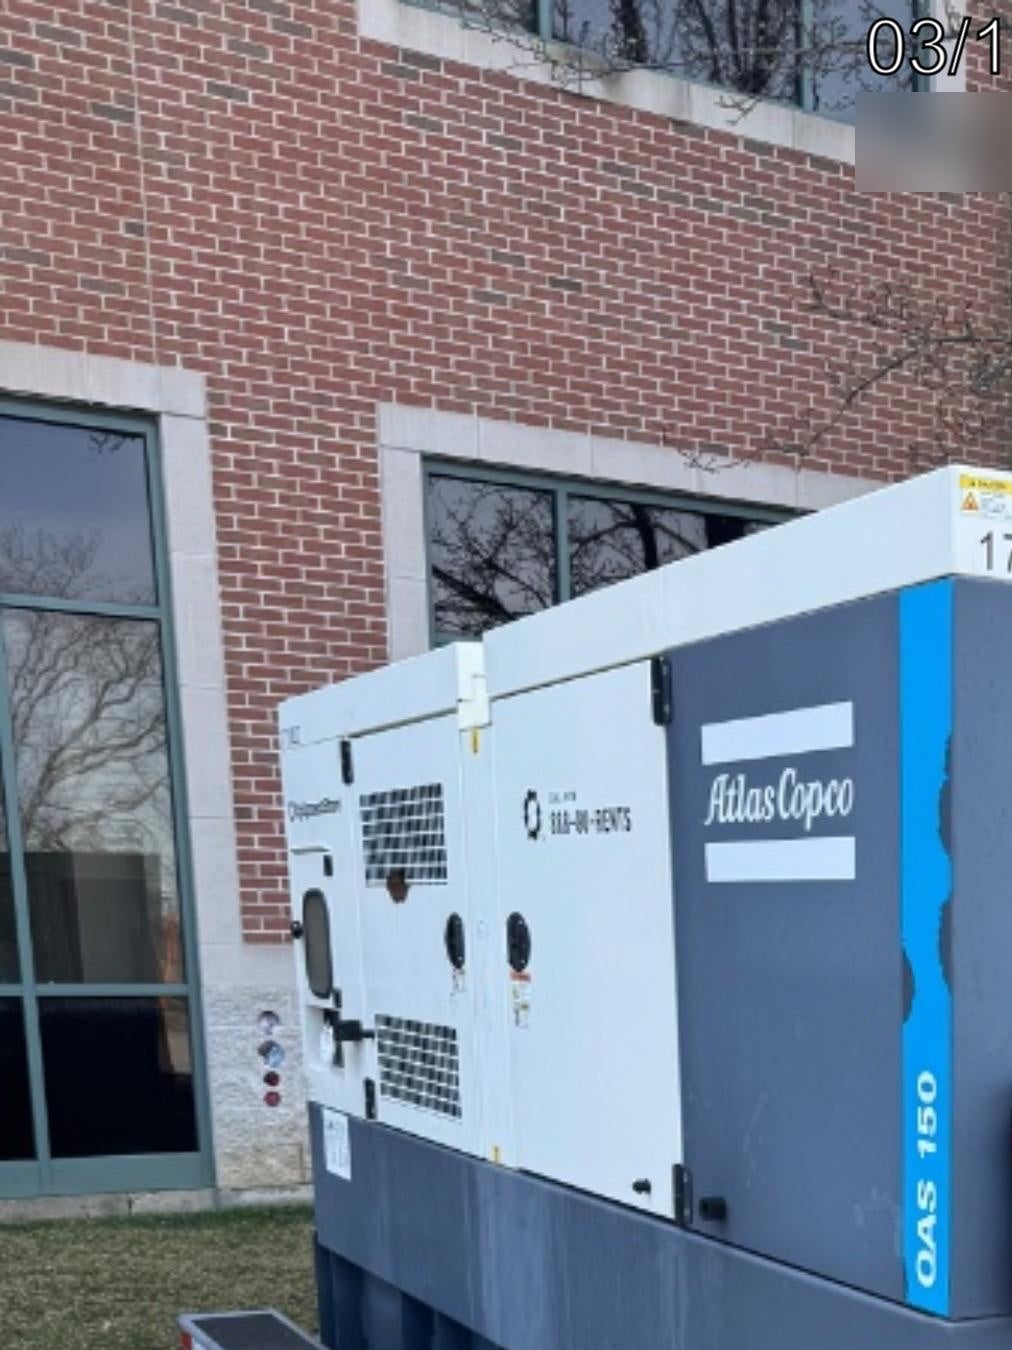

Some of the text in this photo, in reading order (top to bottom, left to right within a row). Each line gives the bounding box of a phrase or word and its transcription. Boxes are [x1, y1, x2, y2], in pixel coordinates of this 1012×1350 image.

[705, 767, 853, 832] Atlas Copco
[916, 1070, 938, 1159] 150
